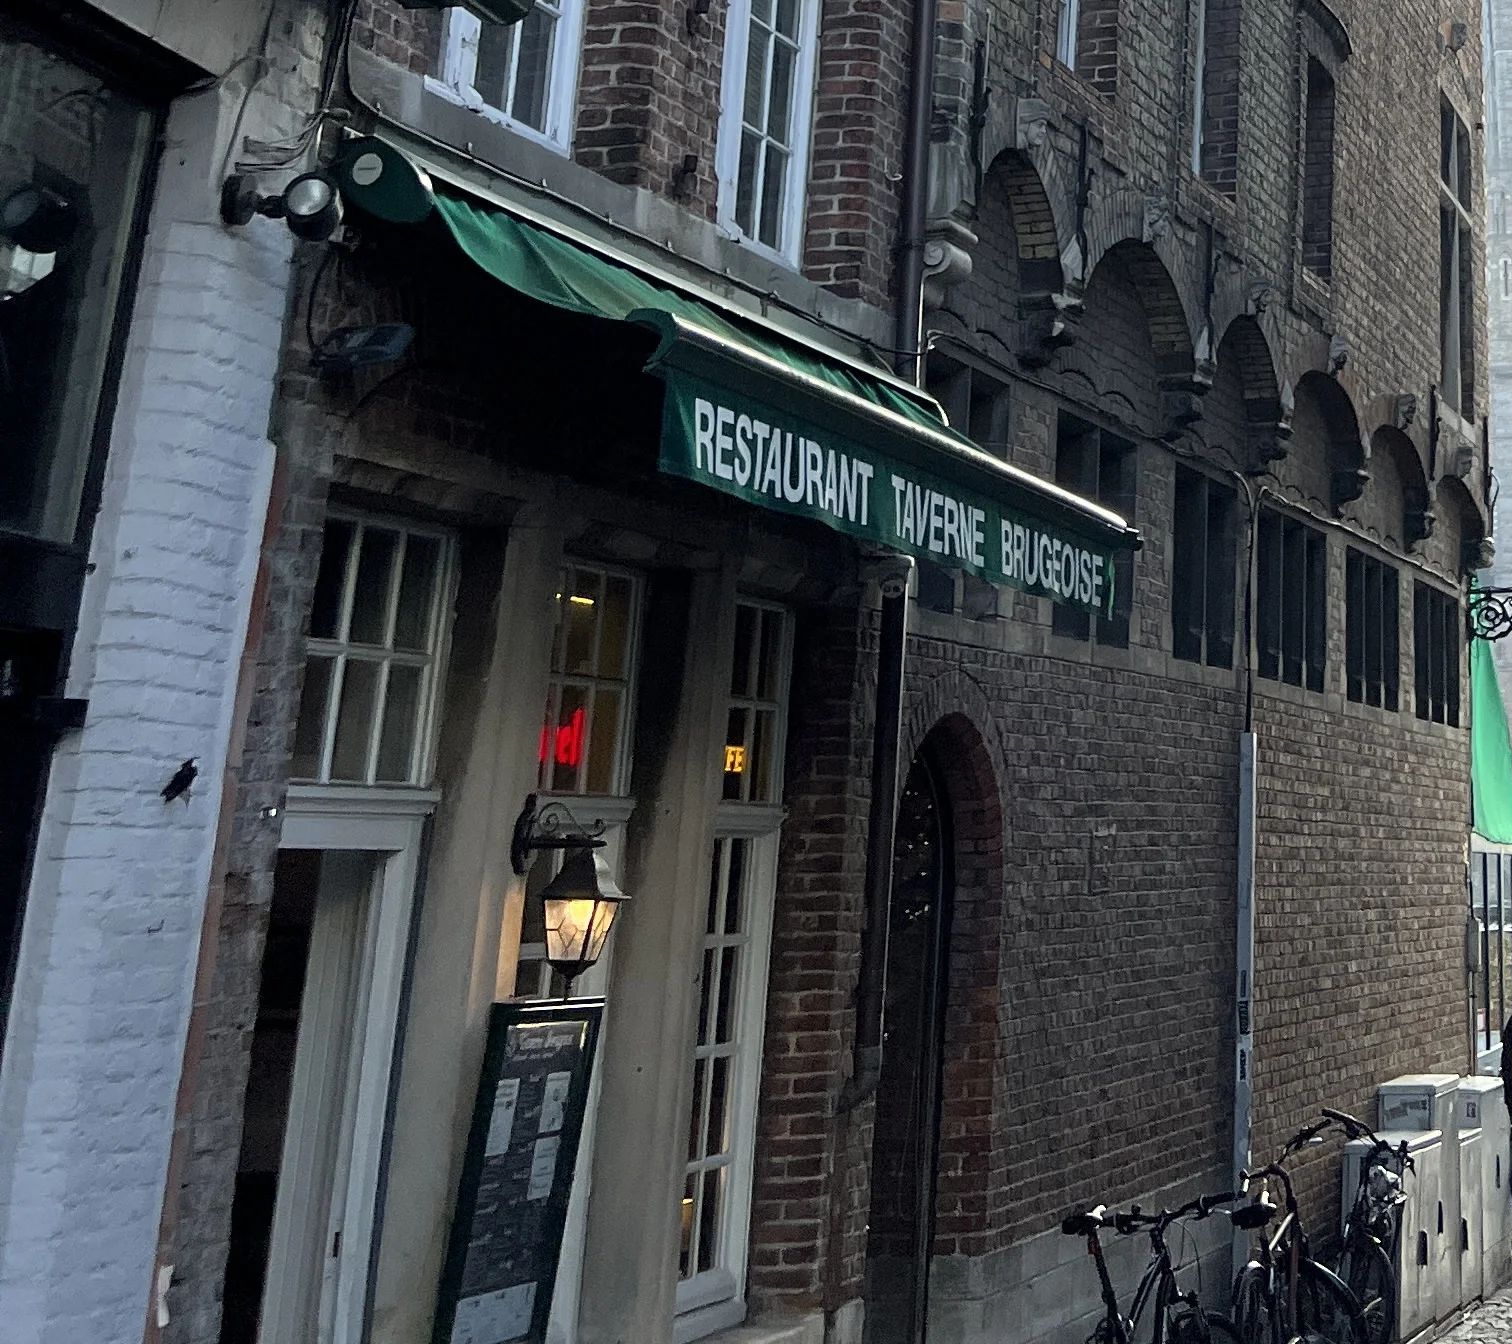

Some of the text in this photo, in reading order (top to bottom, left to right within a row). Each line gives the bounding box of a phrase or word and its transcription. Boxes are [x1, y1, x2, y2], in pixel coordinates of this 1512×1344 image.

[694, 397, 1104, 608] RESTAURANT TAVERNE BRUGEOISE
